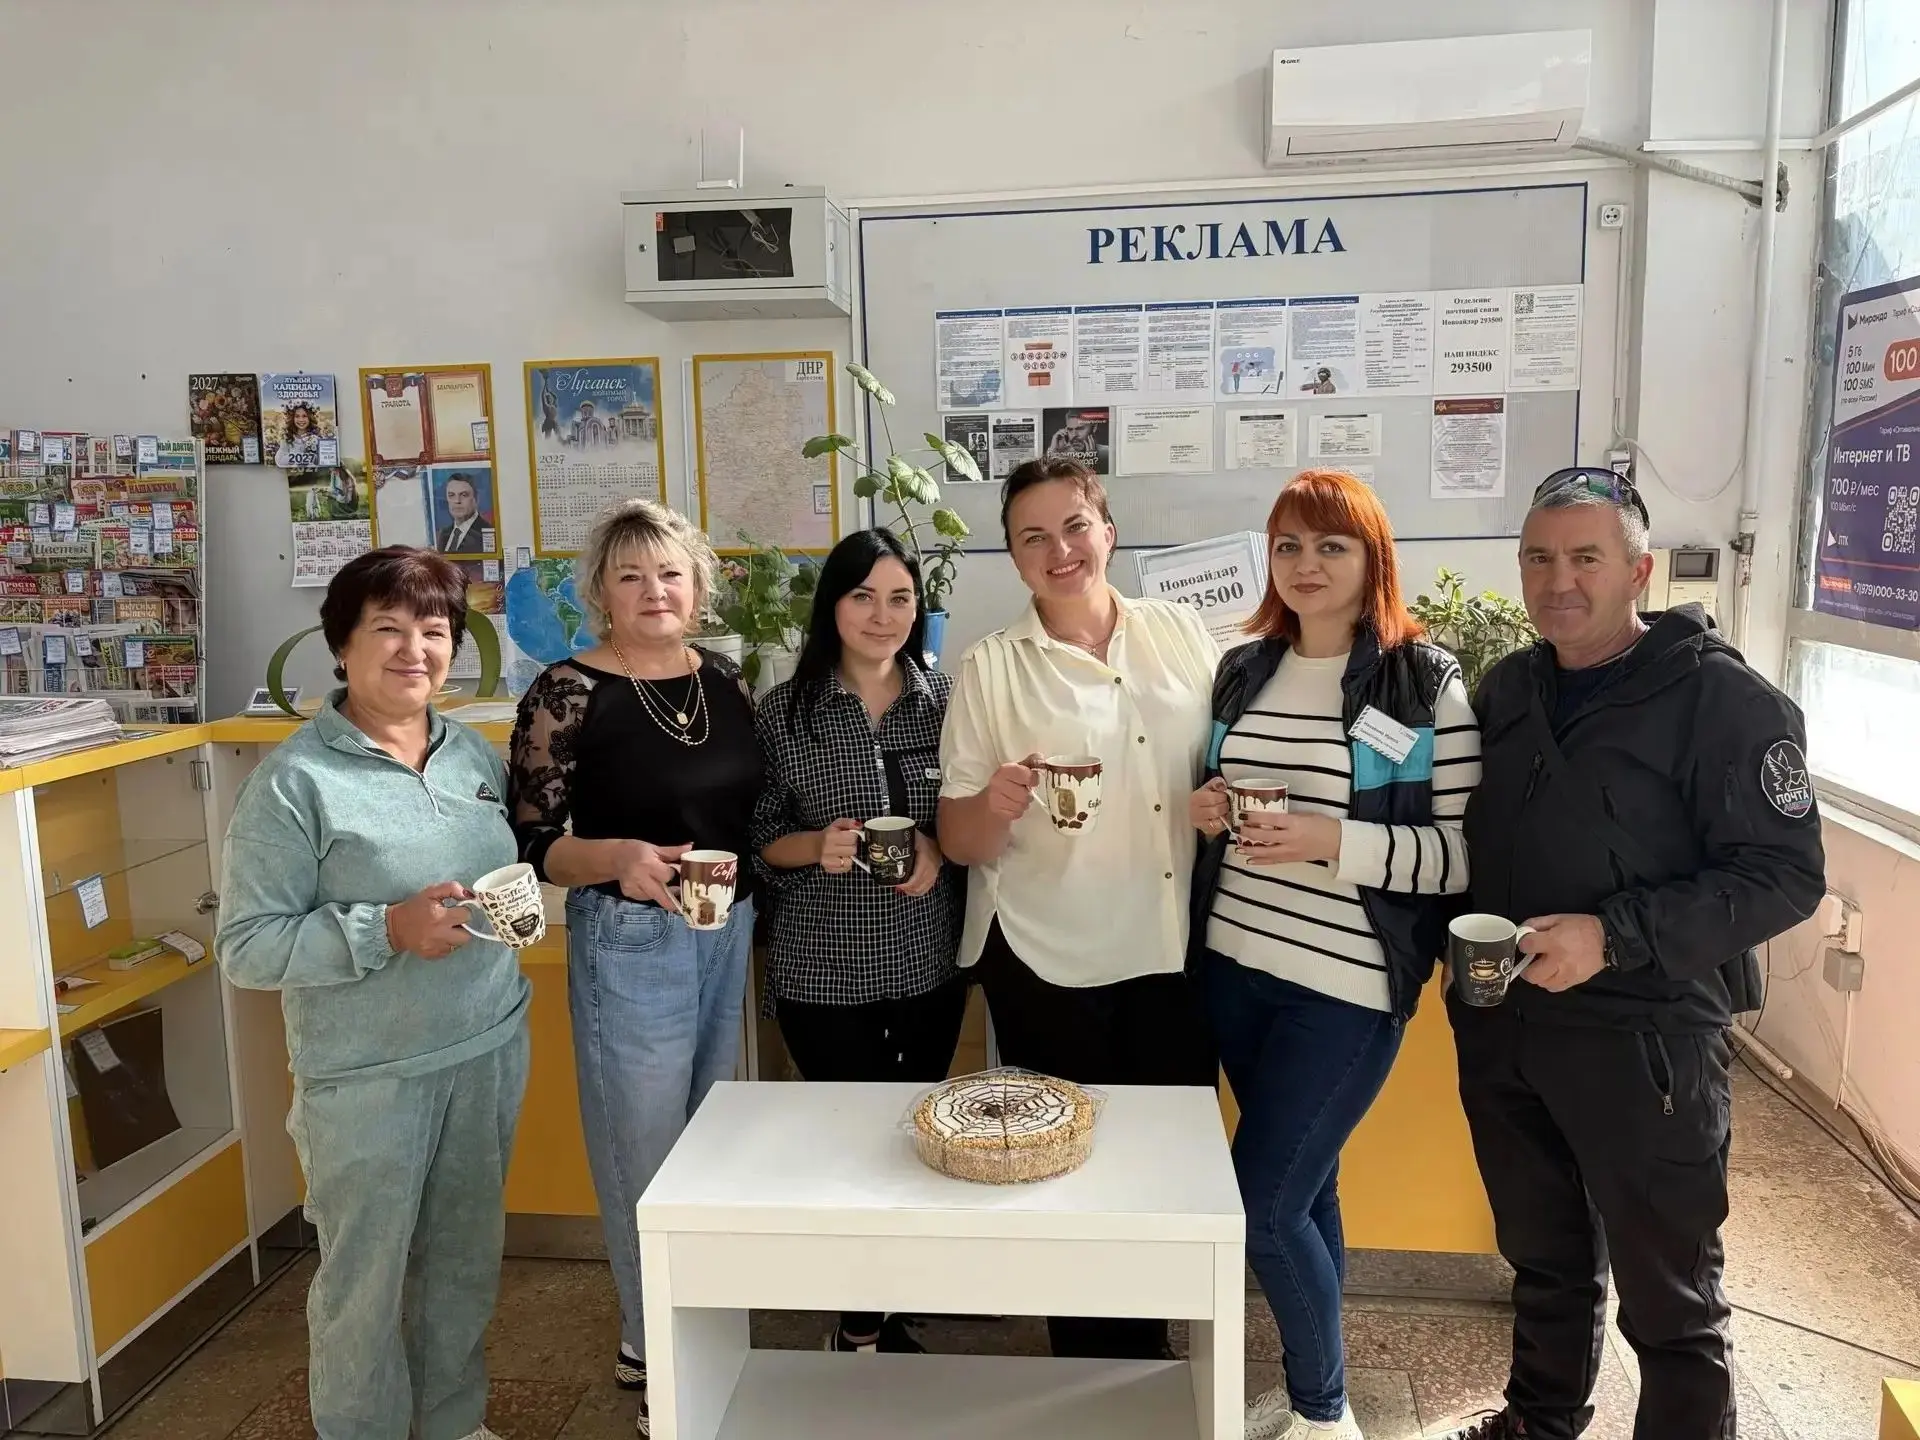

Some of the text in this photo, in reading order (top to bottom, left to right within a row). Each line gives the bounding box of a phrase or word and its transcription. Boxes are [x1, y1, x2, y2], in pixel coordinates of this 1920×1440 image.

[1087, 216, 1347, 264] РЕКЛАМА
[1442, 316, 1503, 326] Новоайдар 293500
[1859, 311, 1888, 326] Миранда
[1466, 350, 1500, 358] ИНДЕКС
[1848, 345, 1854, 358] 5
[1890, 346, 1918, 373] 100
[796, 361, 824, 376] ДНР
[1450, 362, 1492, 373] 293500
[1846, 362, 1861, 375] 100
[191, 377, 219, 390] 2027
[273, 383, 323, 391] КАЛЕНДАРЬ
[555, 368, 627, 396] Луганск
[1844, 377, 1874, 391] 100 SMS
[278, 391, 320, 399] ЗДОРОВЬЯ
[205, 446, 239, 454] НЕЖНЫЙ
[1833, 444, 1910, 467] Интернет и ТВ
[288, 453, 315, 464] 2027
[539, 454, 566, 464] 2027
[1831, 478, 1850, 496] 700
[1160, 565, 1238, 592] Новоайдар
[1167, 582, 1244, 612] 3500
[1776, 789, 1809, 805] ПОЧТА
[497, 885, 527, 900] Coffee
